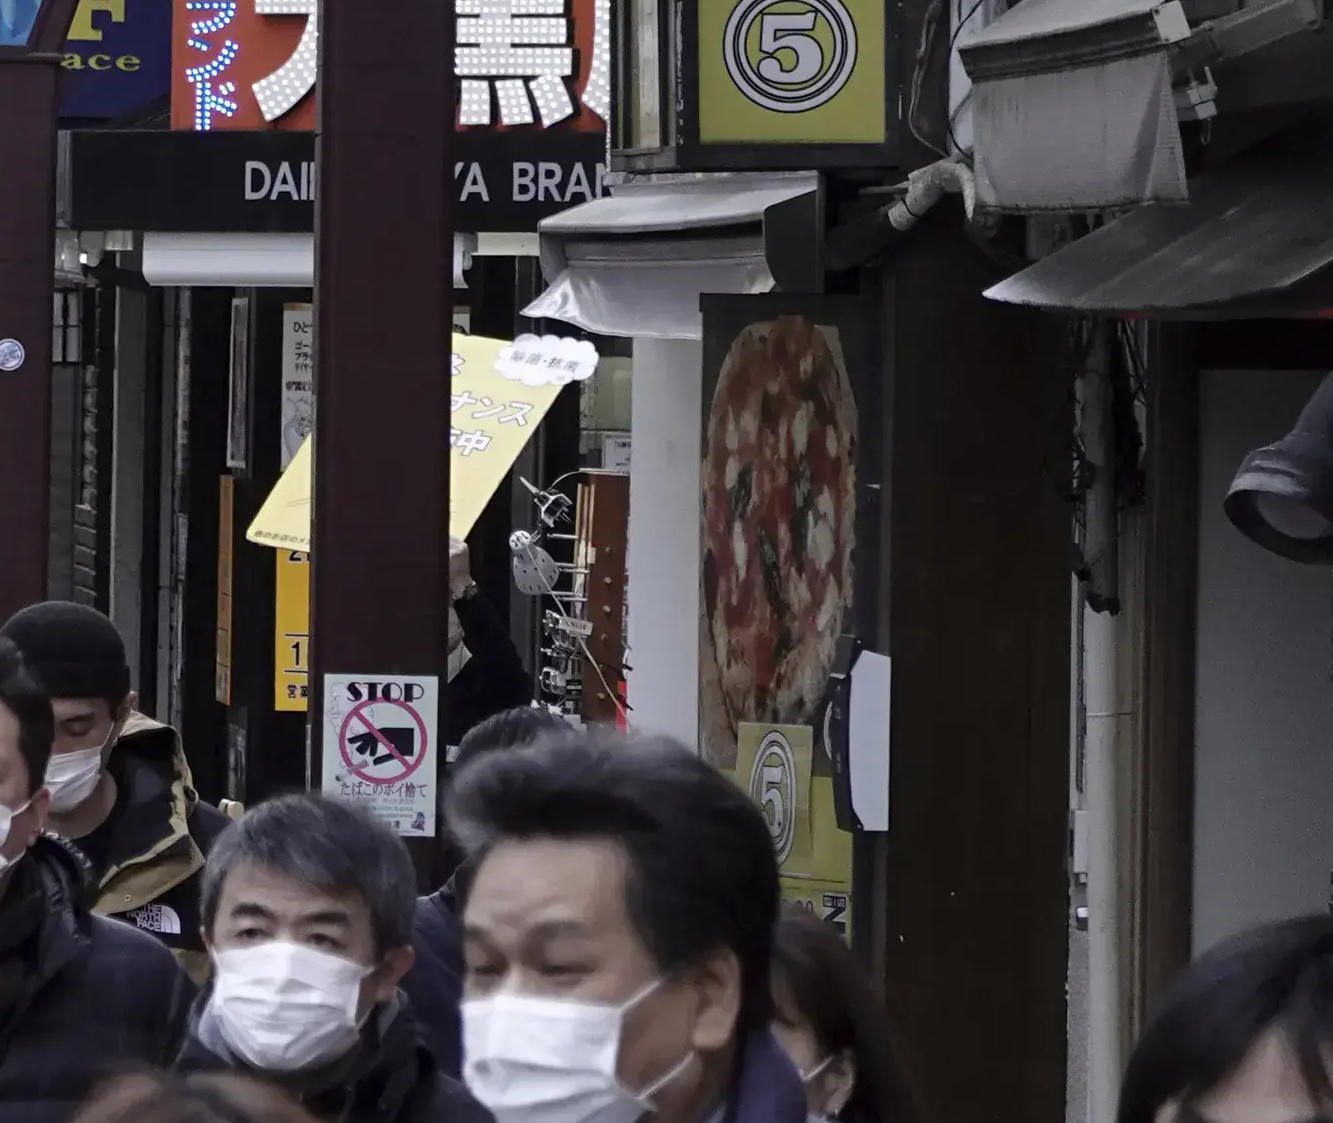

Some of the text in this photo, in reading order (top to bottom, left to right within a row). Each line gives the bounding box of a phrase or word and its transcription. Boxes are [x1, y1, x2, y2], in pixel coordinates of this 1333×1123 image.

[756, 8, 825, 85] 5
[61, 51, 142, 72] ace
[346, 681, 425, 703] STOP
[339, 781, 428, 798] たばこのポイ捨て
